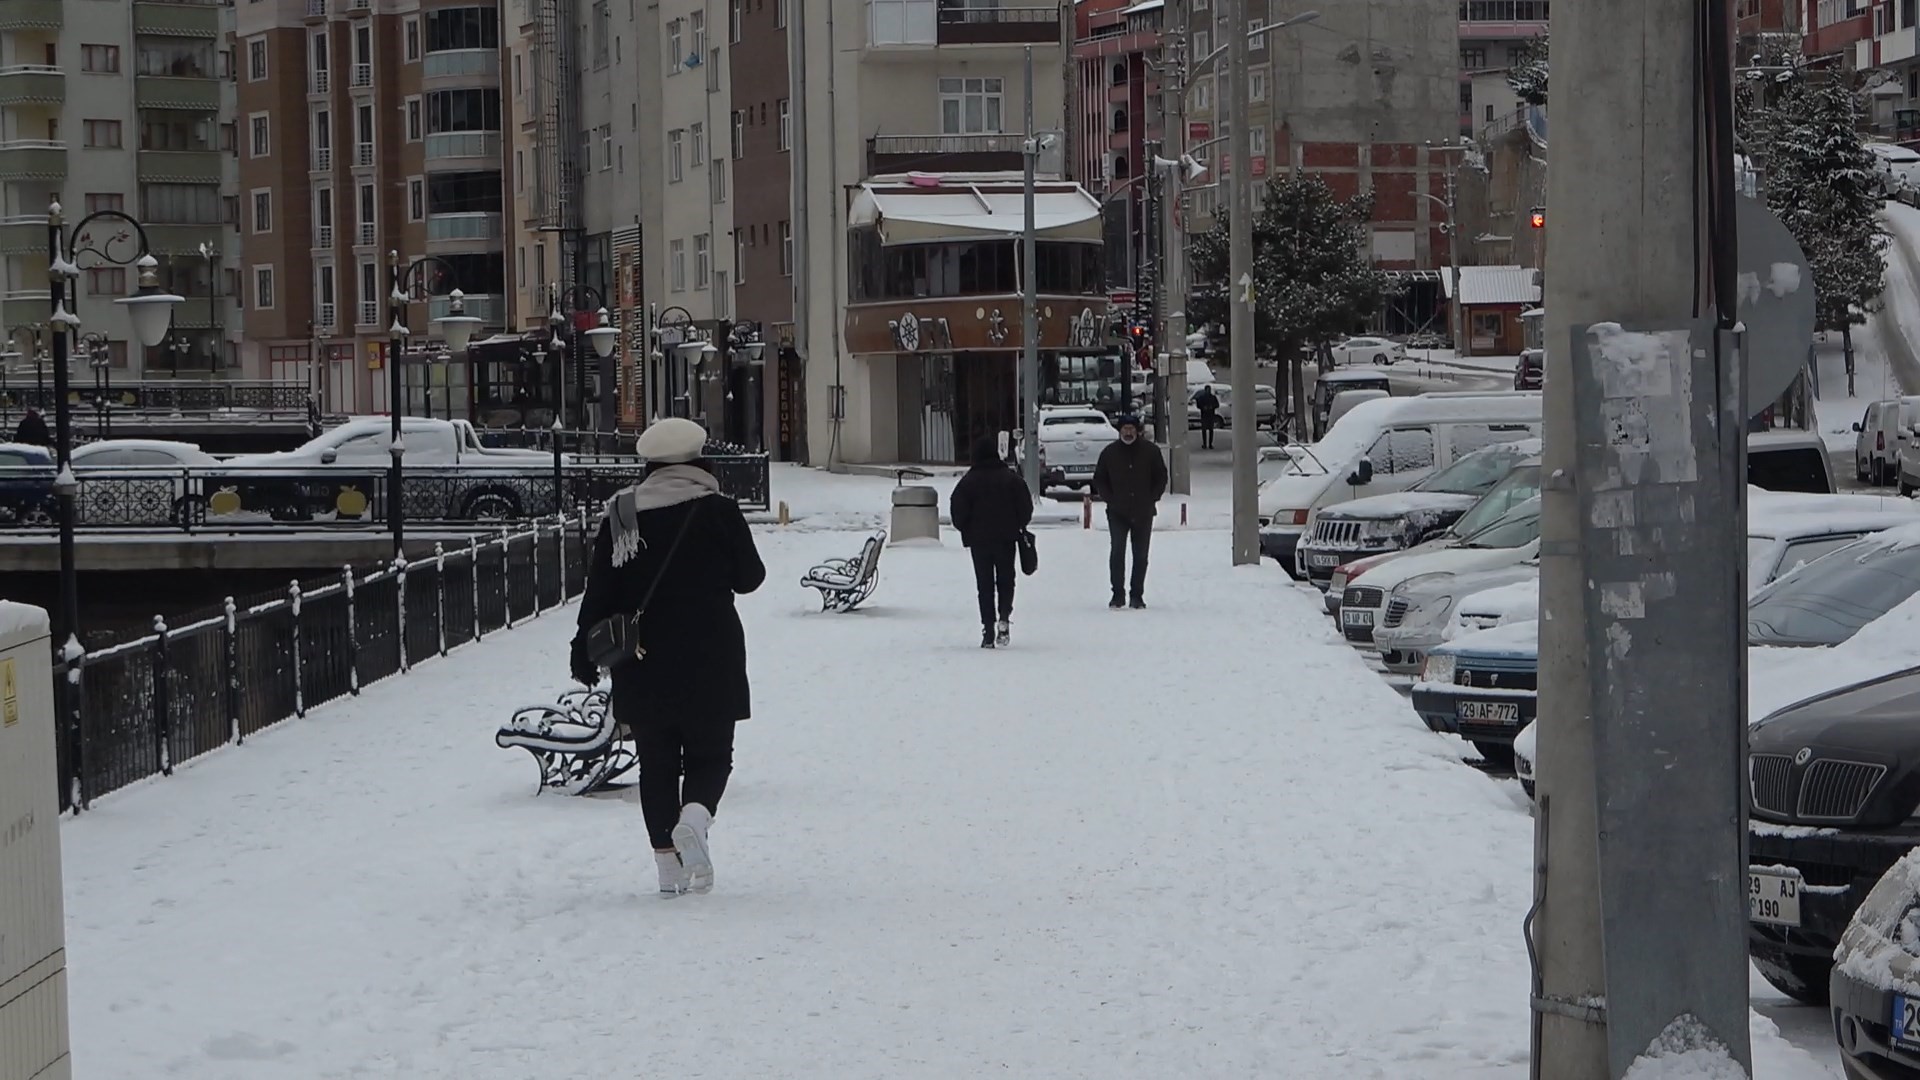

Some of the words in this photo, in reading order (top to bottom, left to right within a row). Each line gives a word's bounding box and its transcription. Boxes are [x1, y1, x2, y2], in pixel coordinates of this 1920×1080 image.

[1463, 702, 1475, 718] 29
[1479, 703, 1494, 719] AF
[1497, 704, 1517, 720] 772
[1780, 879, 1796, 898] AJ
[1758, 898, 1779, 918] 190
